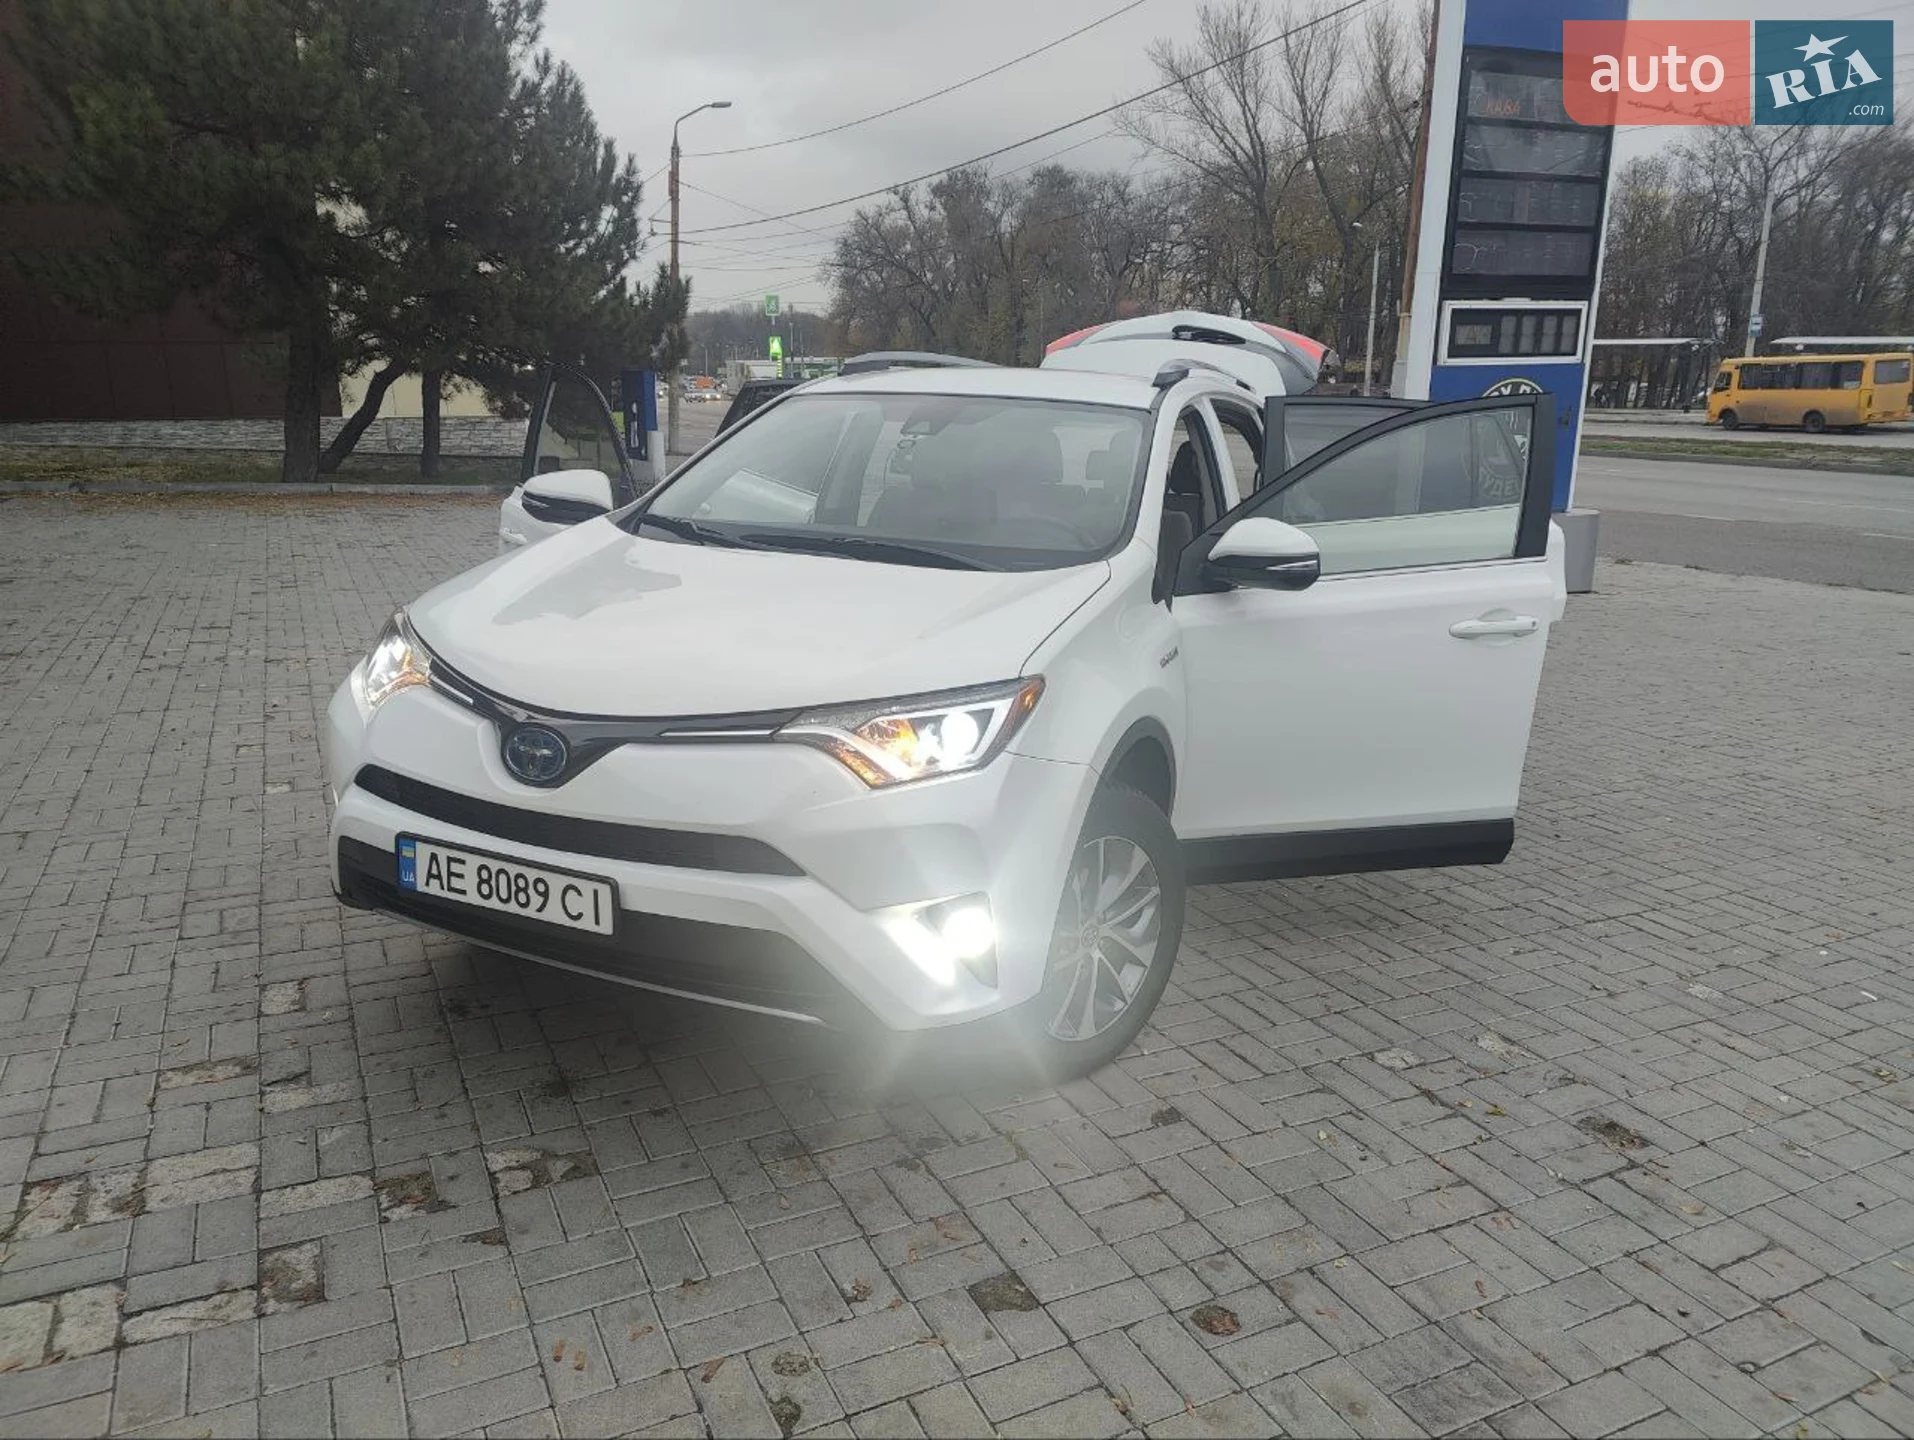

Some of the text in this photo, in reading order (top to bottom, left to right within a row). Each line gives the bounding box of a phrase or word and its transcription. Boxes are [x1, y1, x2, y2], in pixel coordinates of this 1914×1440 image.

[424, 851, 601, 927] AE 8089 CI
